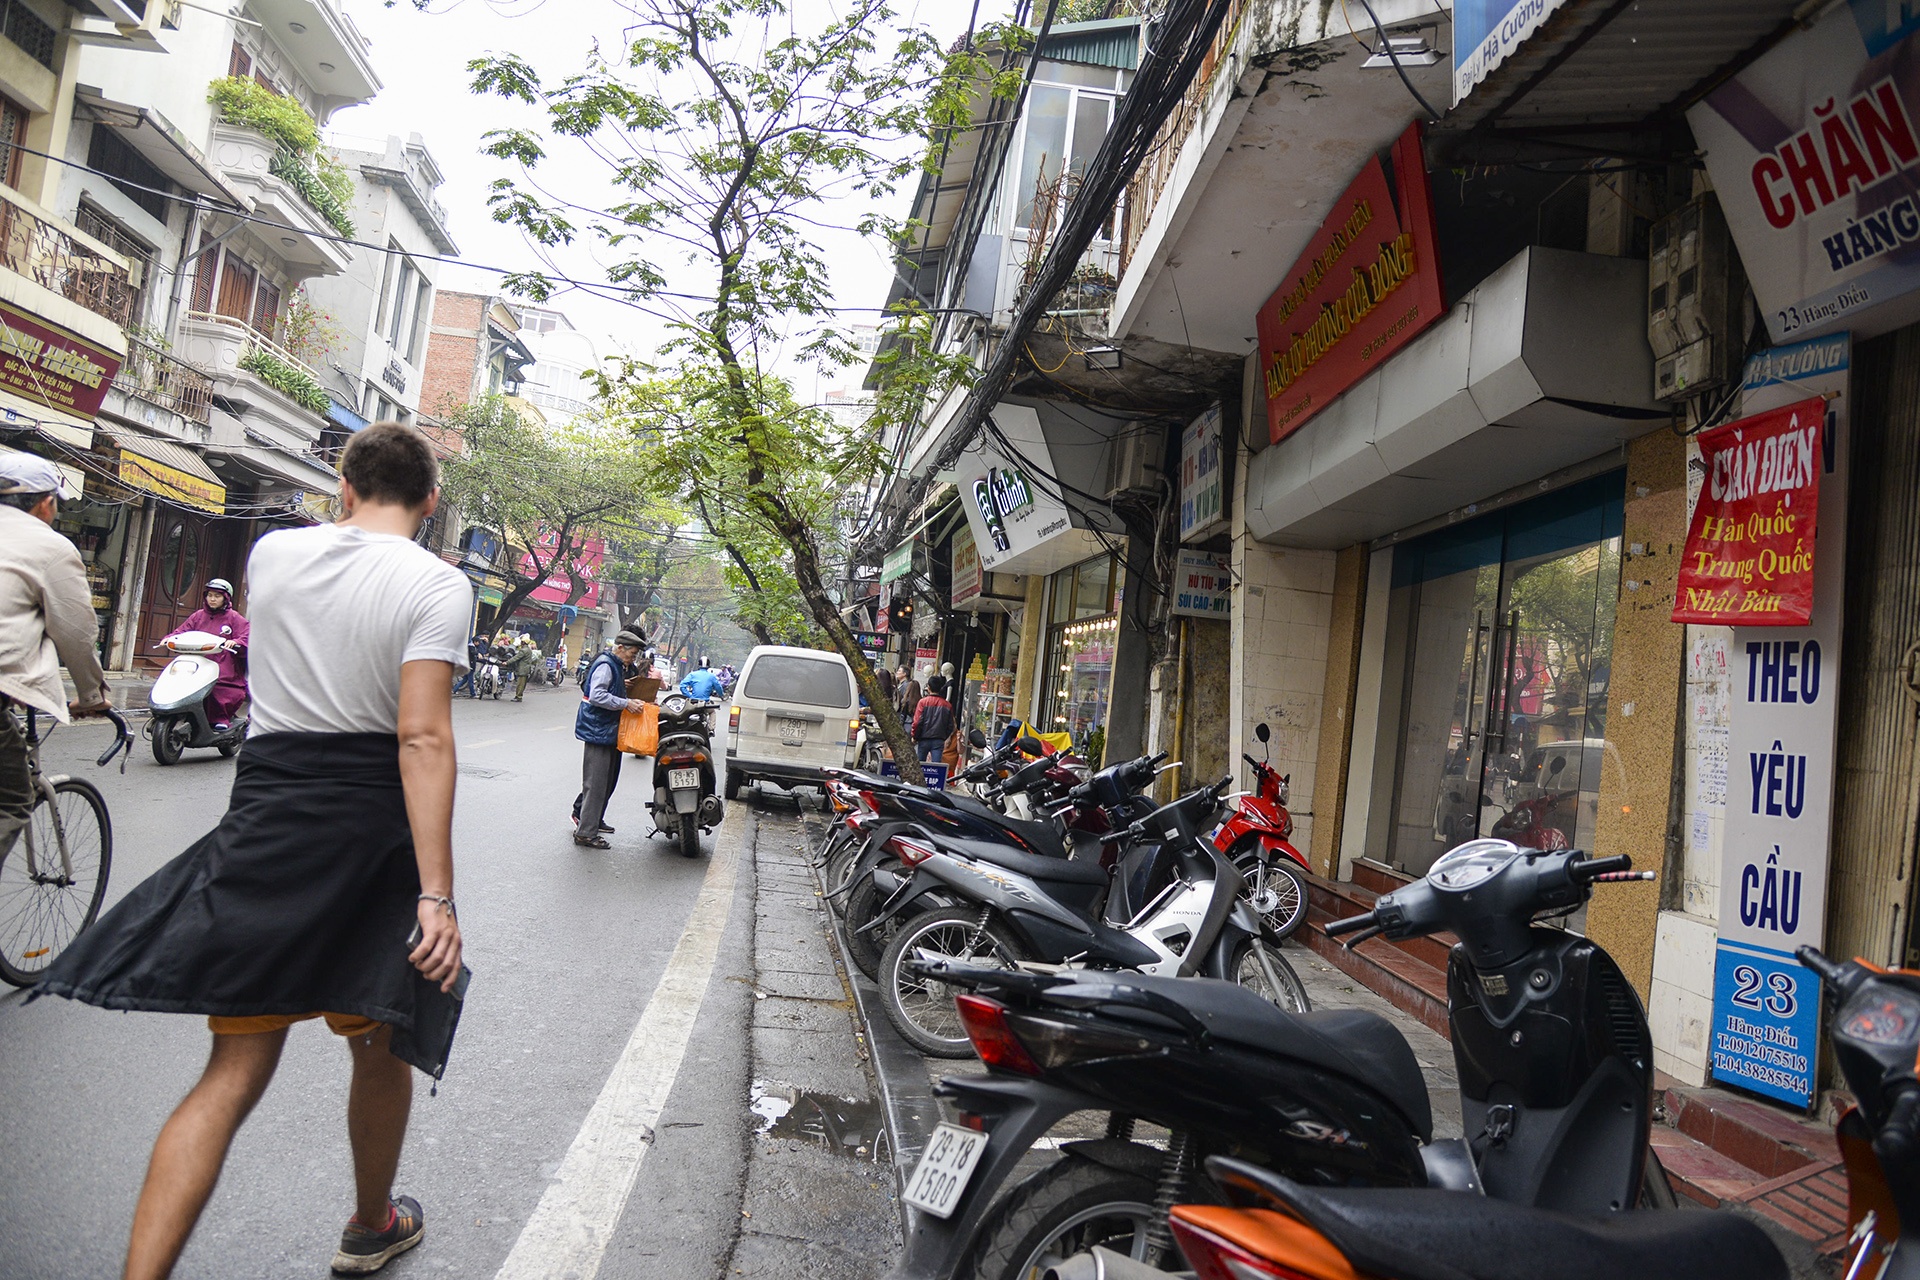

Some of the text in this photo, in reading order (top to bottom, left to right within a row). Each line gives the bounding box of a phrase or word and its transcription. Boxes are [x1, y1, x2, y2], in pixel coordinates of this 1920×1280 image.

[1483, 35, 1499, 66] Hà
[1502, 0, 1544, 45] Cường
[1751, 81, 1919, 230] CHĂN
[1822, 201, 1919, 271] HÀNG
[1304, 299, 1347, 365] PHƯỜNG
[1369, 235, 1412, 302] ĐÔNG
[1778, 283, 1869, 333] 23 Hàng Điếu
[1778, 343, 1843, 377] CƯỜNG
[1758, 413, 1816, 508] ĐIỆN
[1699, 500, 1796, 544] Hàn Quốc
[1693, 538, 1812, 584] Trung Quốc
[1683, 587, 1782, 619] Nhật Bản
[1746, 639, 1821, 705] THEO
[674, 778, 695, 787] 5157
[1750, 740, 1806, 819] YÊU
[1172, 909, 1202, 917] HONDA
[1740, 845, 1802, 935] CẦU
[1732, 965, 1798, 1018] 23
[1717, 1033, 1808, 1074] T.0912075518
[1727, 1015, 1798, 1050] Hàng Điếu
[1715, 1051, 1808, 1095] T.04.38285544
[928, 1130, 976, 1170] 29-Y8
[912, 1166, 957, 1208] 1500
